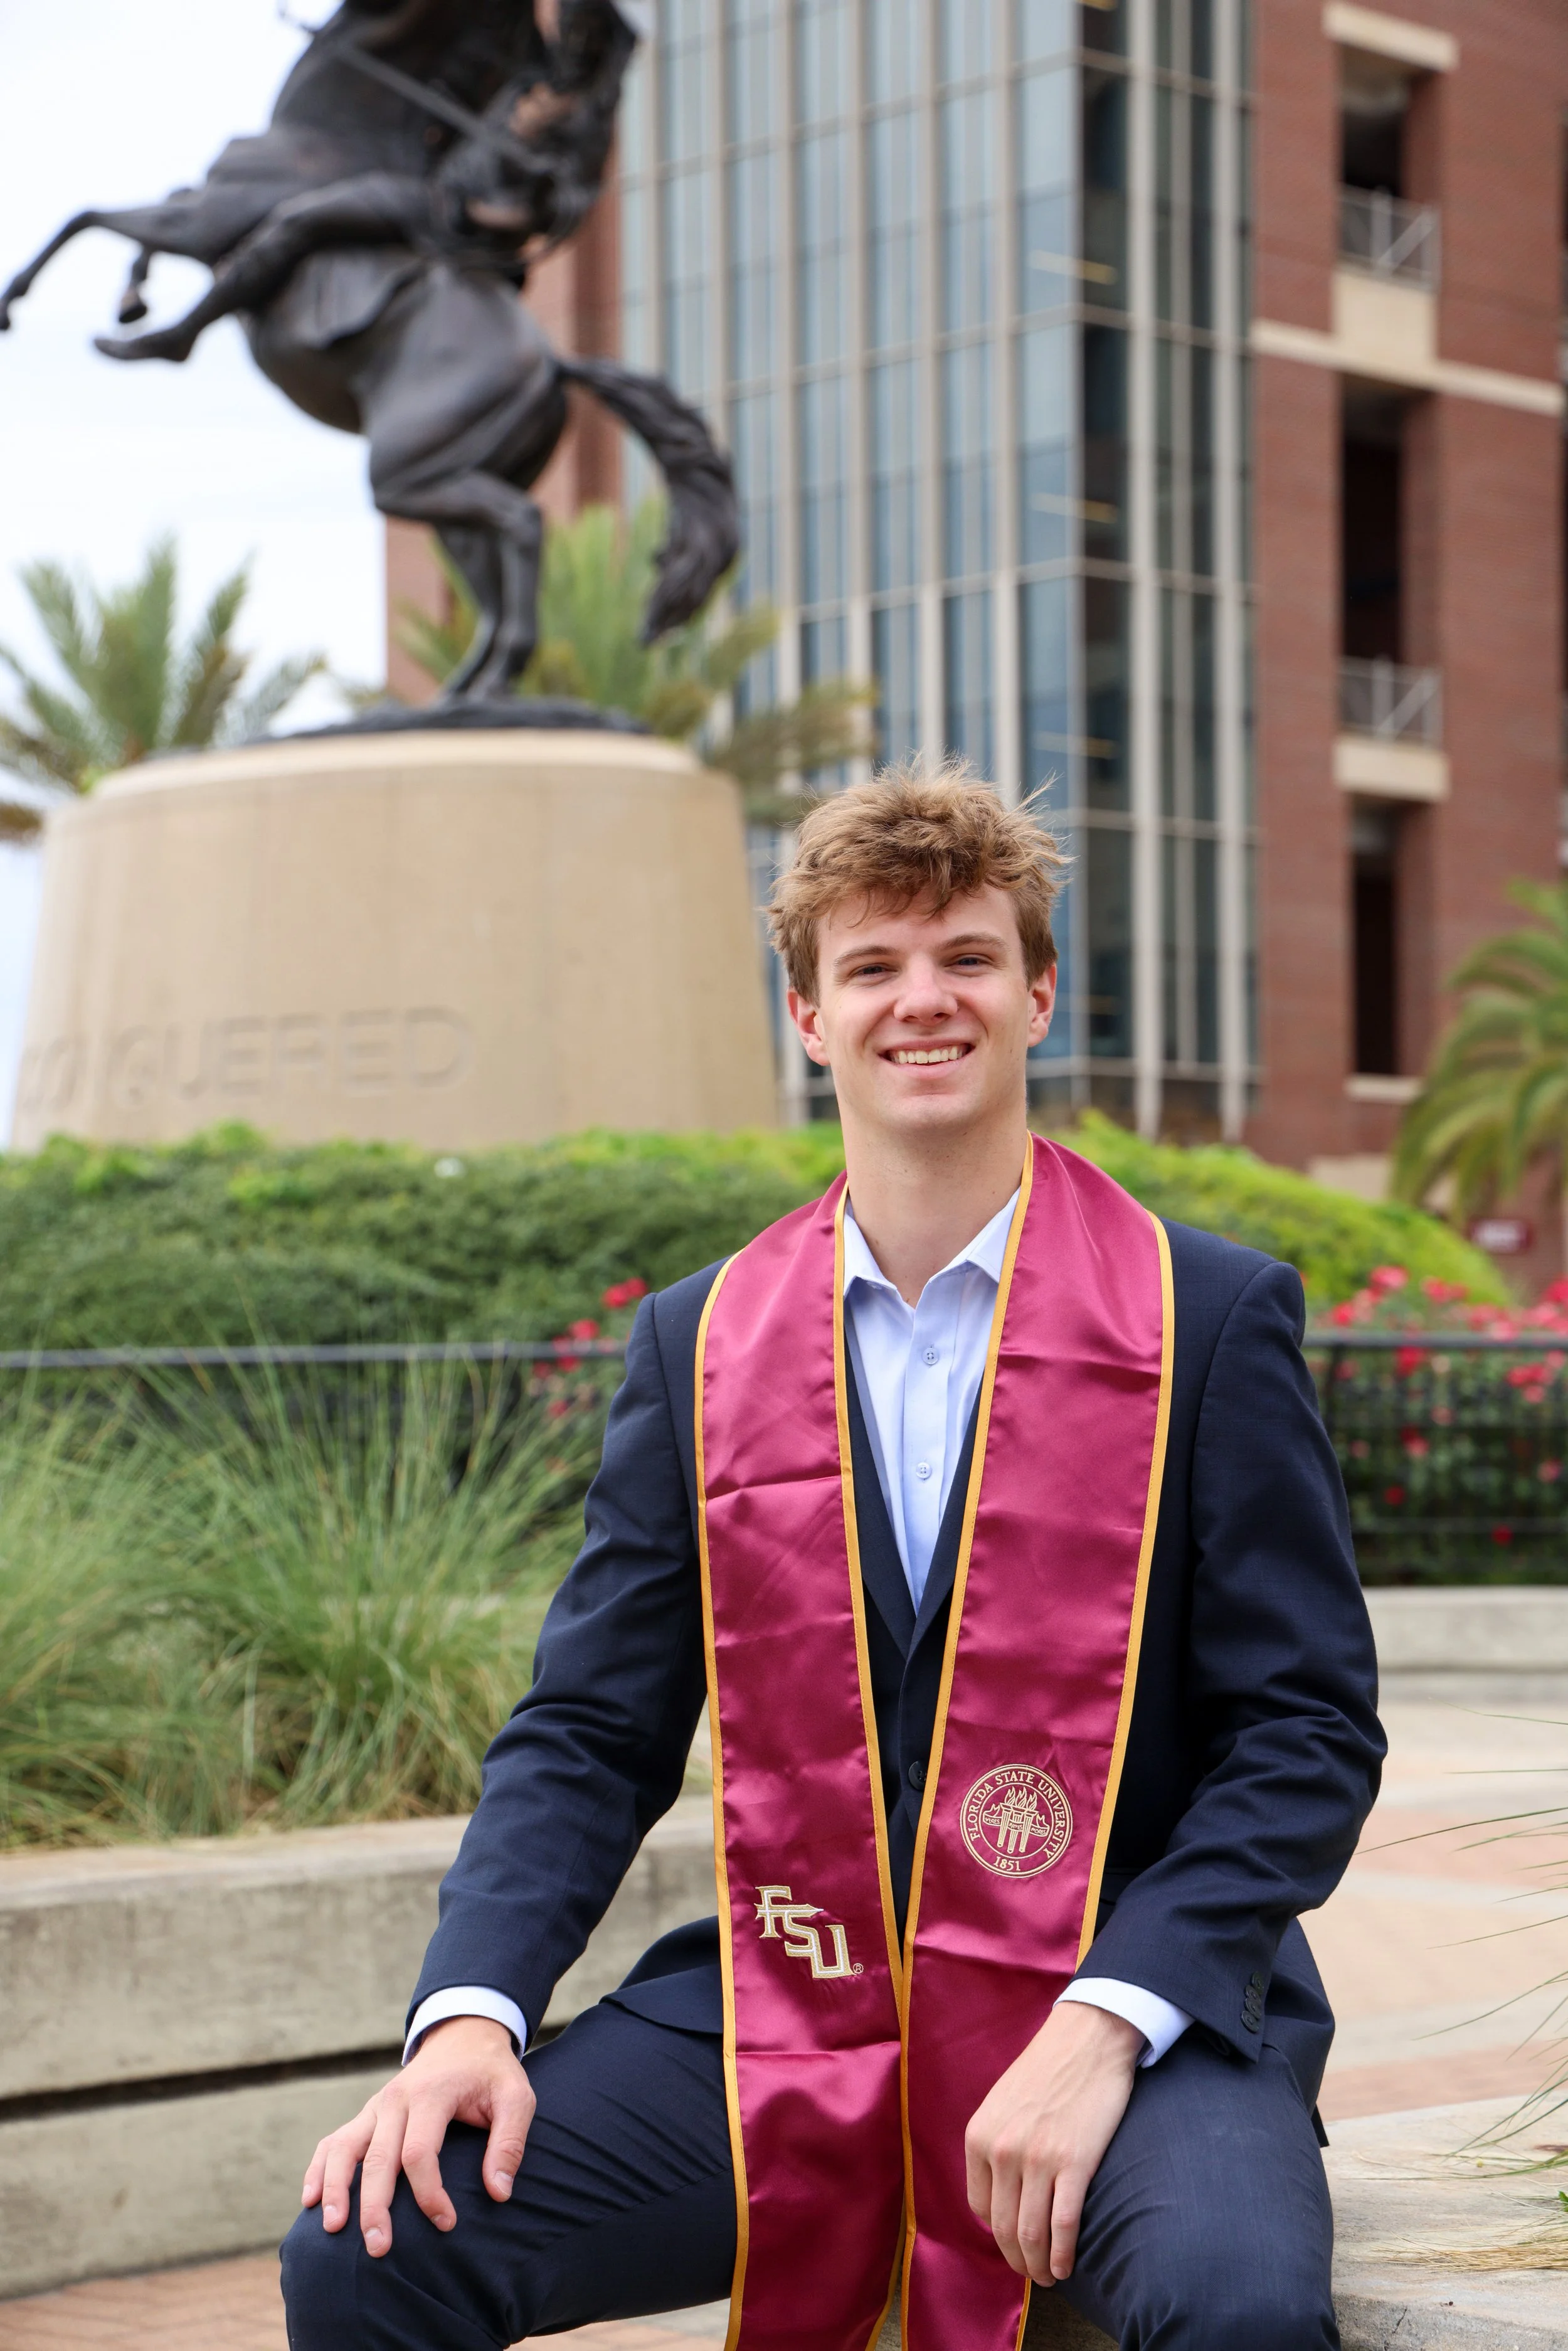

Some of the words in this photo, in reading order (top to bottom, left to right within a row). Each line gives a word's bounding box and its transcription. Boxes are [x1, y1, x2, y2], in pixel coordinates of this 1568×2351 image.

[968, 1783, 993, 1841] FLORIDA
[995, 1771, 1035, 1785] STATE
[1038, 1780, 1065, 1859] UNIVERSITY
[993, 1856, 1021, 1871] 1851
[753, 1885, 857, 1978] FSU
